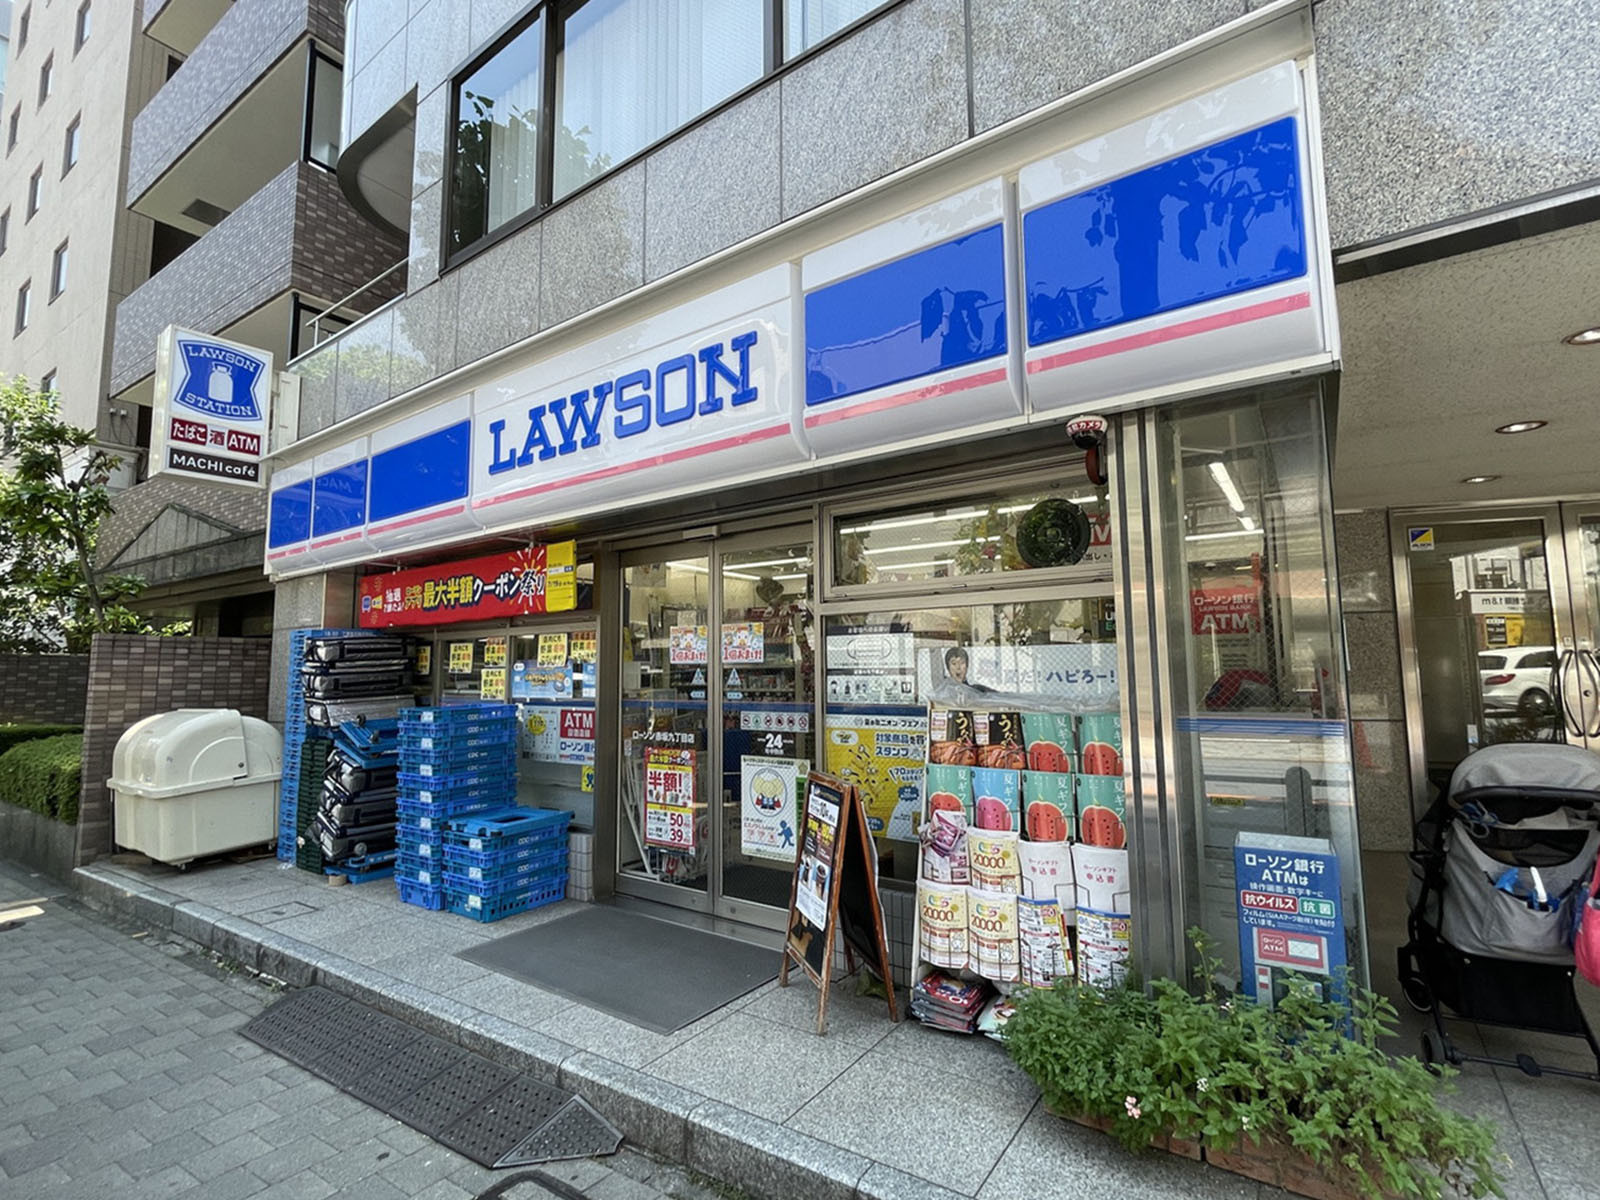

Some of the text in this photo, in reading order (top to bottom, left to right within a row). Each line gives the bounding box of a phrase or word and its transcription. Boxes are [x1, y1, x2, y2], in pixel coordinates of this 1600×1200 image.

[187, 346, 257, 372] LAWSON
[185, 392, 252, 416] STATION
[489, 330, 757, 475] LAWSON
[173, 421, 206, 442] たばこ
[228, 433, 259, 452] ATM
[173, 454, 223, 473] MACHI
[1194, 593, 1255, 605] ローソン銀行
[1200, 612, 1250, 631] ATM
[564, 712, 593, 729] ATM
[765, 733, 784, 749] 24
[648, 770, 682, 793] 半額!
[669, 813, 684, 827] 50
[669, 828, 684, 842] 39
[1245, 853, 1325, 875] ローソン銀行
[1261, 869, 1309, 886] ATMは
[1244, 893, 1295, 910] 抗ウイルス
[1263, 945, 1284, 953] ATM
